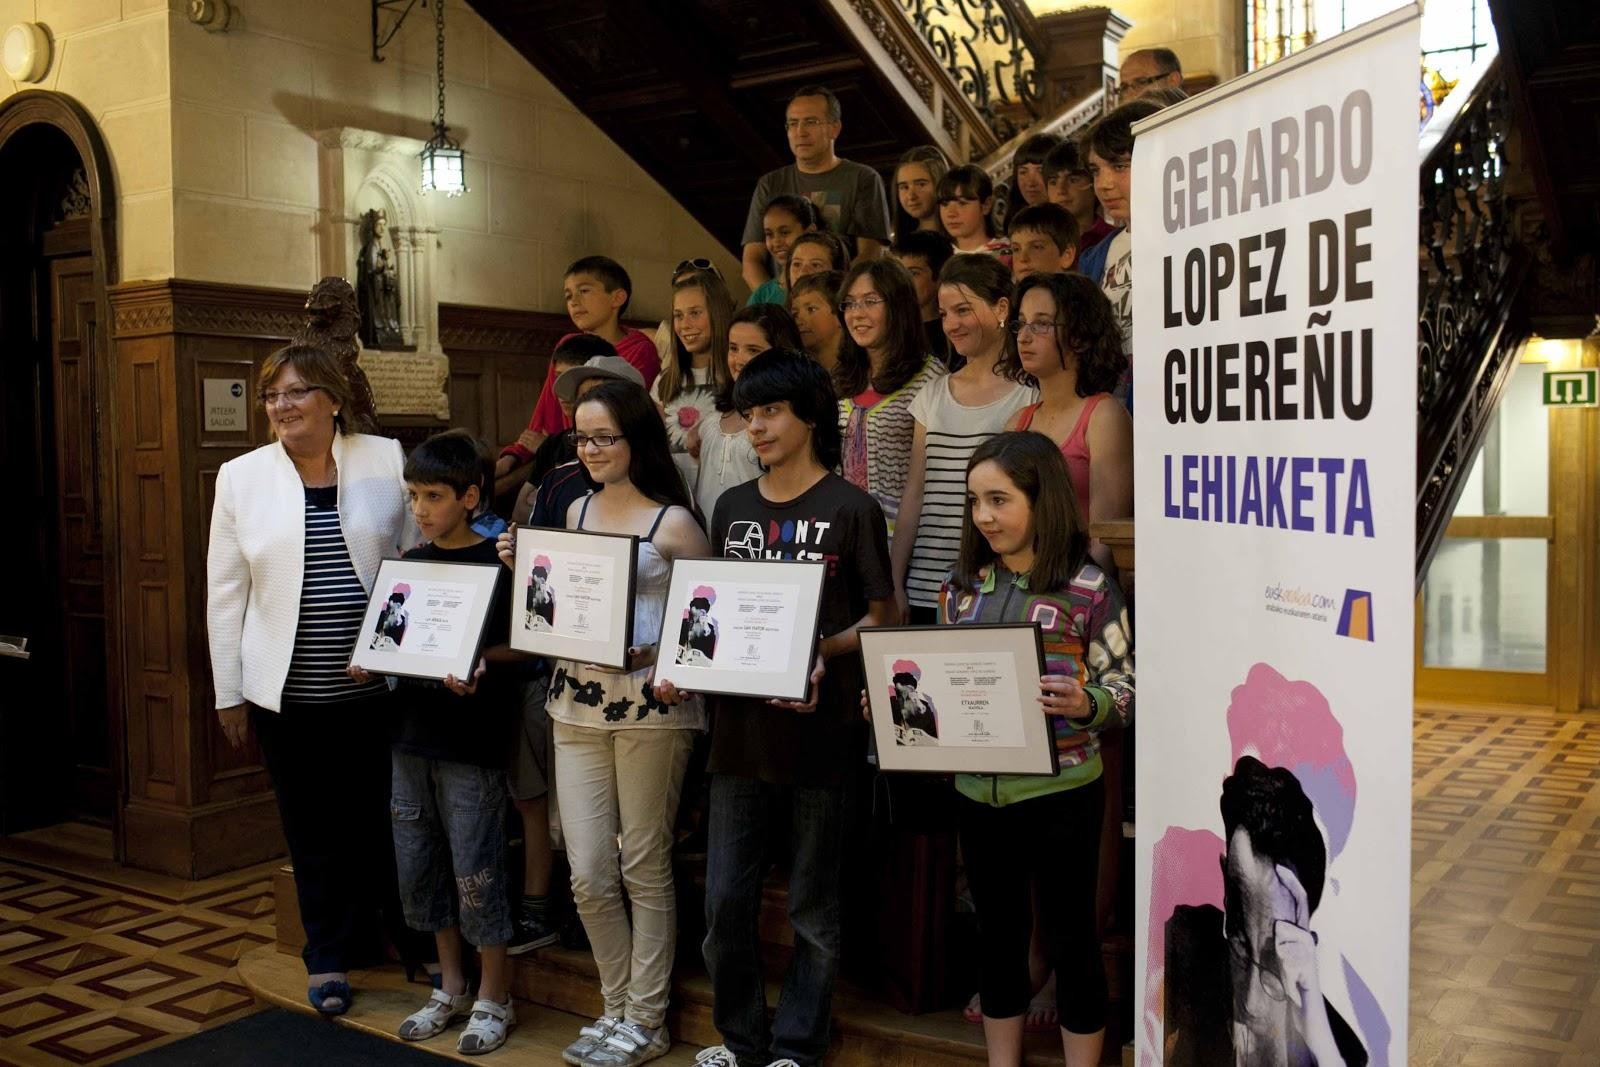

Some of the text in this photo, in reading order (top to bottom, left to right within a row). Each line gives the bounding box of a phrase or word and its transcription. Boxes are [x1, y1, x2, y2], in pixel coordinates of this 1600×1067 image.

[1162, 88, 1374, 235] GERARDO
[1163, 207, 1374, 329] LOPEZ DE
[1164, 310, 1374, 425] GUEREÑU
[210, 418, 236, 427] SALIDA
[767, 517, 831, 546] DON'T
[1164, 454, 1376, 538] LEHIAKETA
